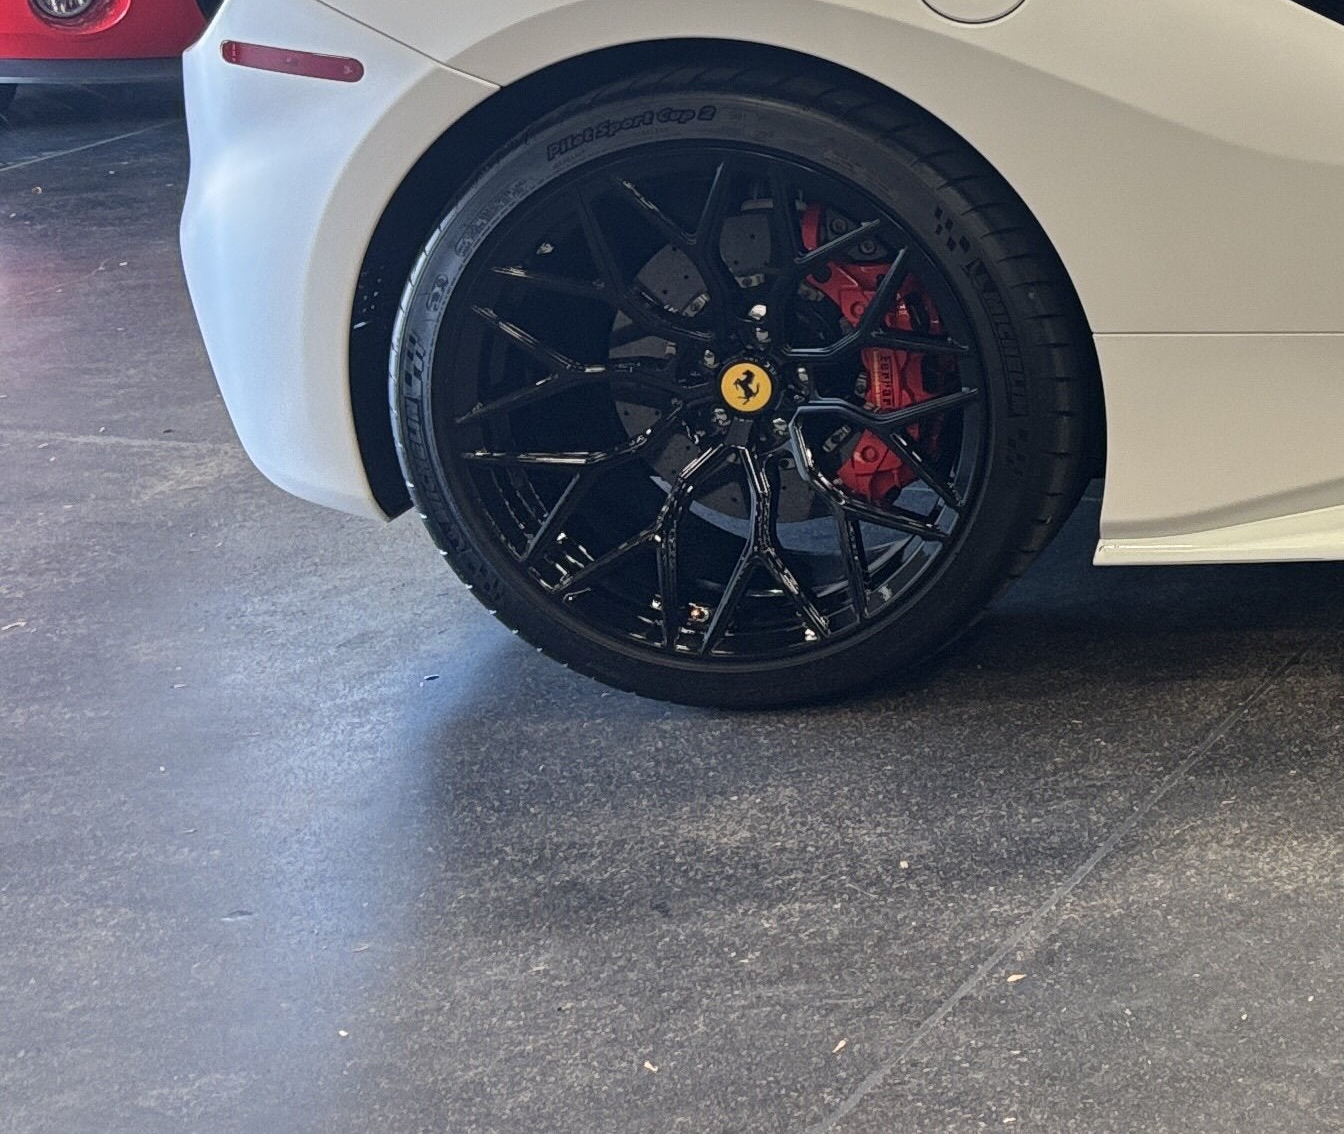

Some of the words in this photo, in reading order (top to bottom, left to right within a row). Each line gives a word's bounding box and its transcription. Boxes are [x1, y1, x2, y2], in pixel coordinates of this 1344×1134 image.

[547, 127, 594, 162] Pilot
[595, 110, 653, 139] Sport
[656, 106, 696, 125] Cup
[698, 105, 717, 121] 2
